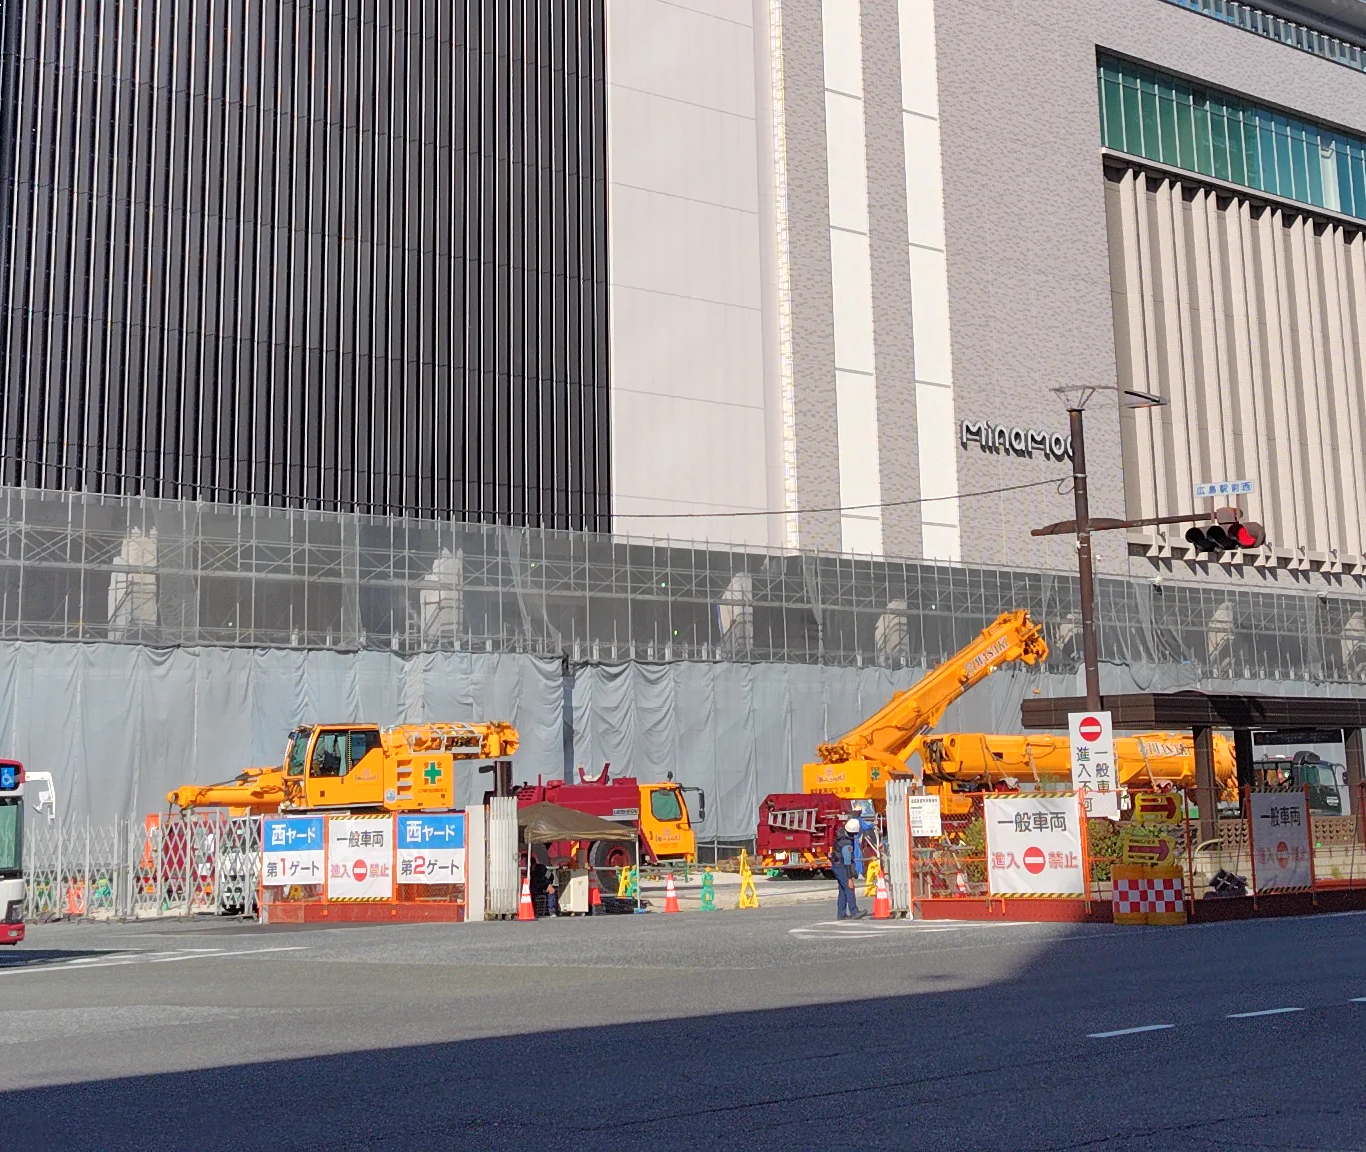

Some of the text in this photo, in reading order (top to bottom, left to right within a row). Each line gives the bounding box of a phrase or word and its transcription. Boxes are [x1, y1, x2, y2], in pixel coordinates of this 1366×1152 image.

[997, 811, 1067, 833] 一般車両
[1260, 805, 1301, 827] 一般車両
[271, 823, 316, 846] 西ヤード
[336, 830, 384, 848] 一般車両
[406, 820, 455, 843] 西ヤード
[266, 857, 320, 878] 第1ゲート
[401, 855, 460, 876] 第2ゲート
[992, 850, 1079, 870] 進入 禁止
[330, 864, 390, 879] 進入 禁止
